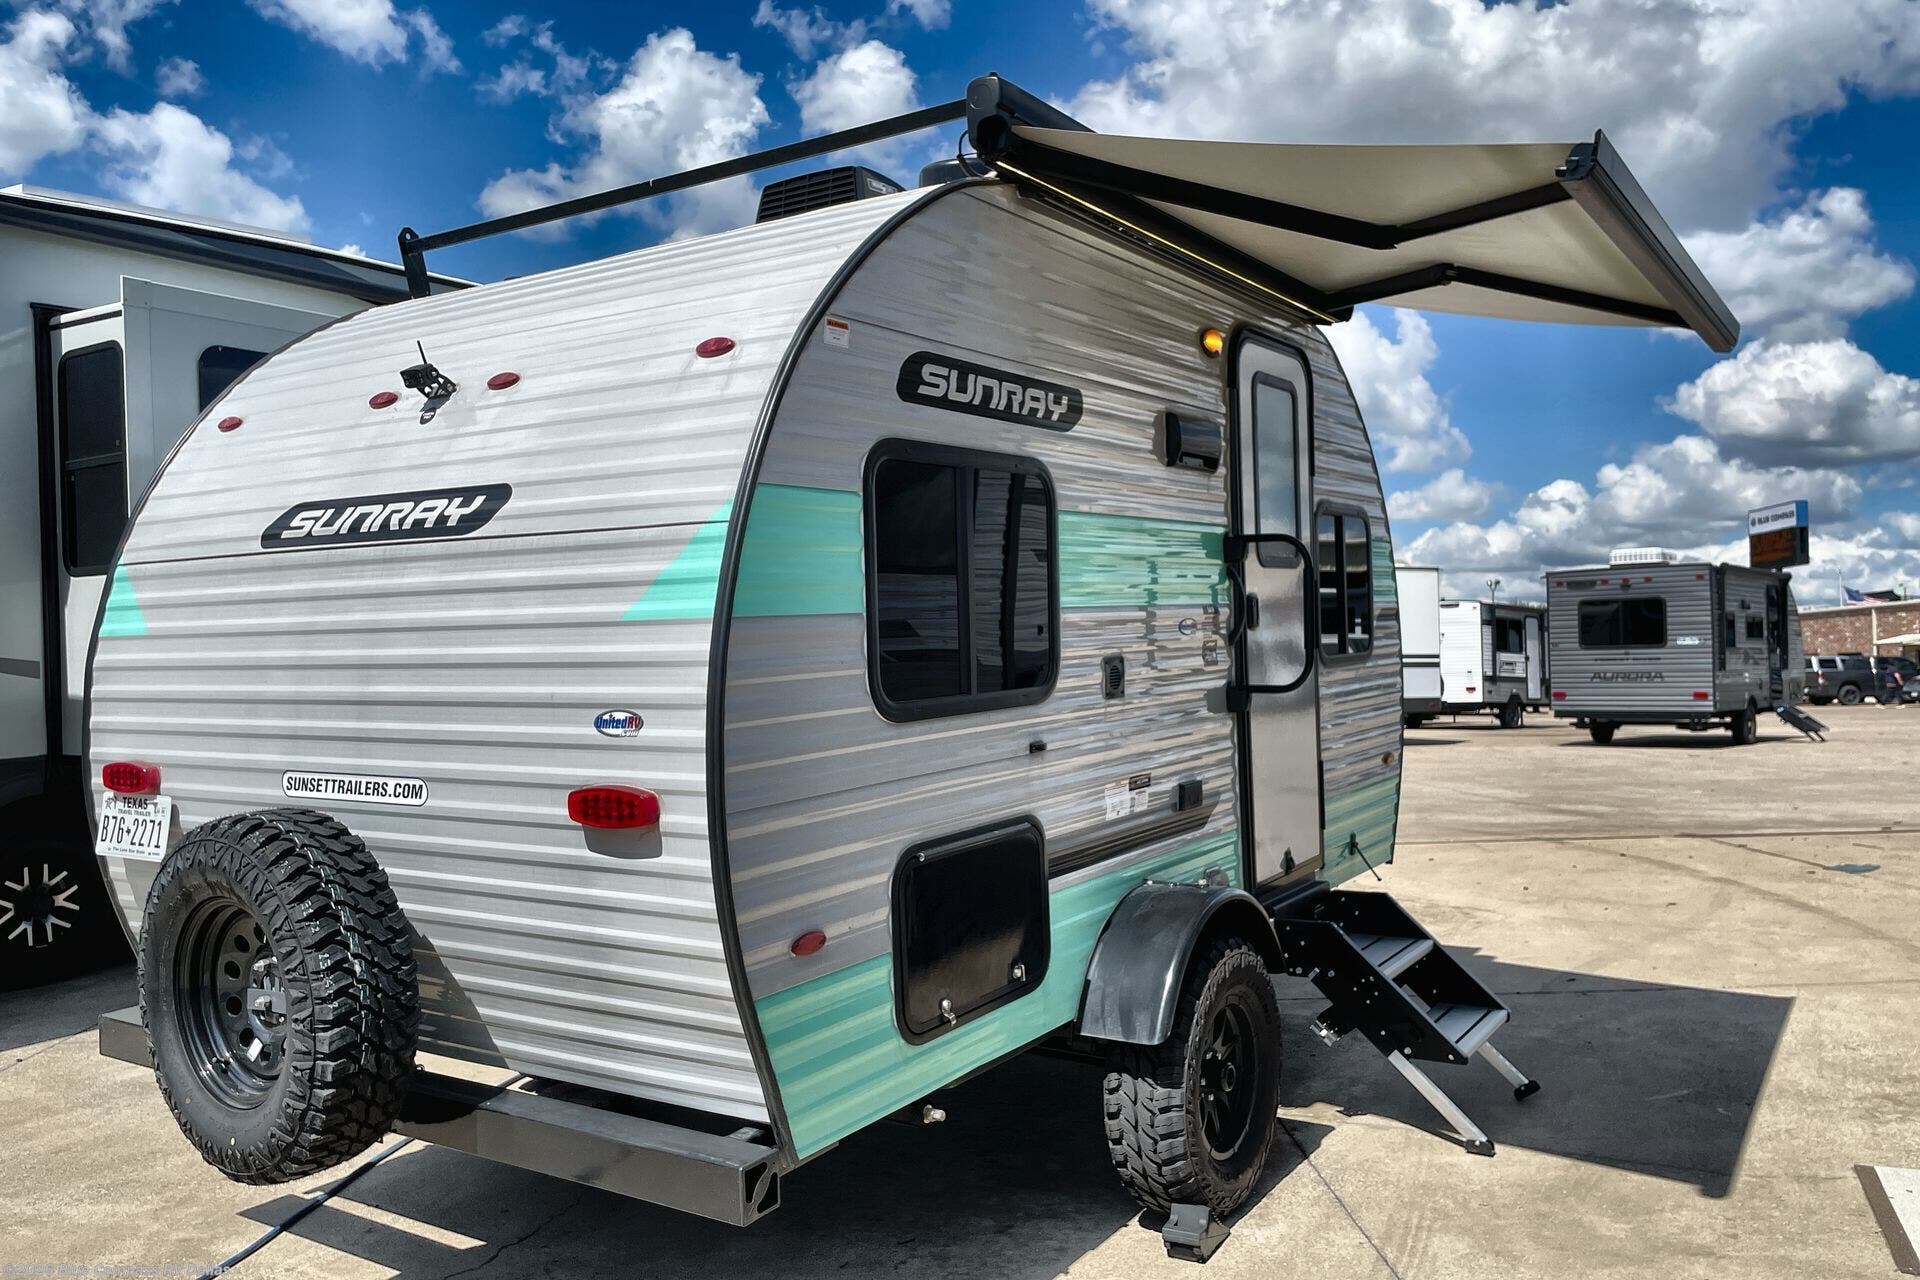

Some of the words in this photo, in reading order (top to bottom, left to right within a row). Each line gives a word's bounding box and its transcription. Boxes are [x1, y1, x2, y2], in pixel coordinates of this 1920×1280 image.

[917, 363, 1068, 422] SUNRAY
[280, 495, 486, 539] SUNRAY
[1590, 671, 1665, 682] AURORA
[286, 776, 423, 799] SUNSETTRAILERS.COM
[122, 796, 149, 810] TEXAS
